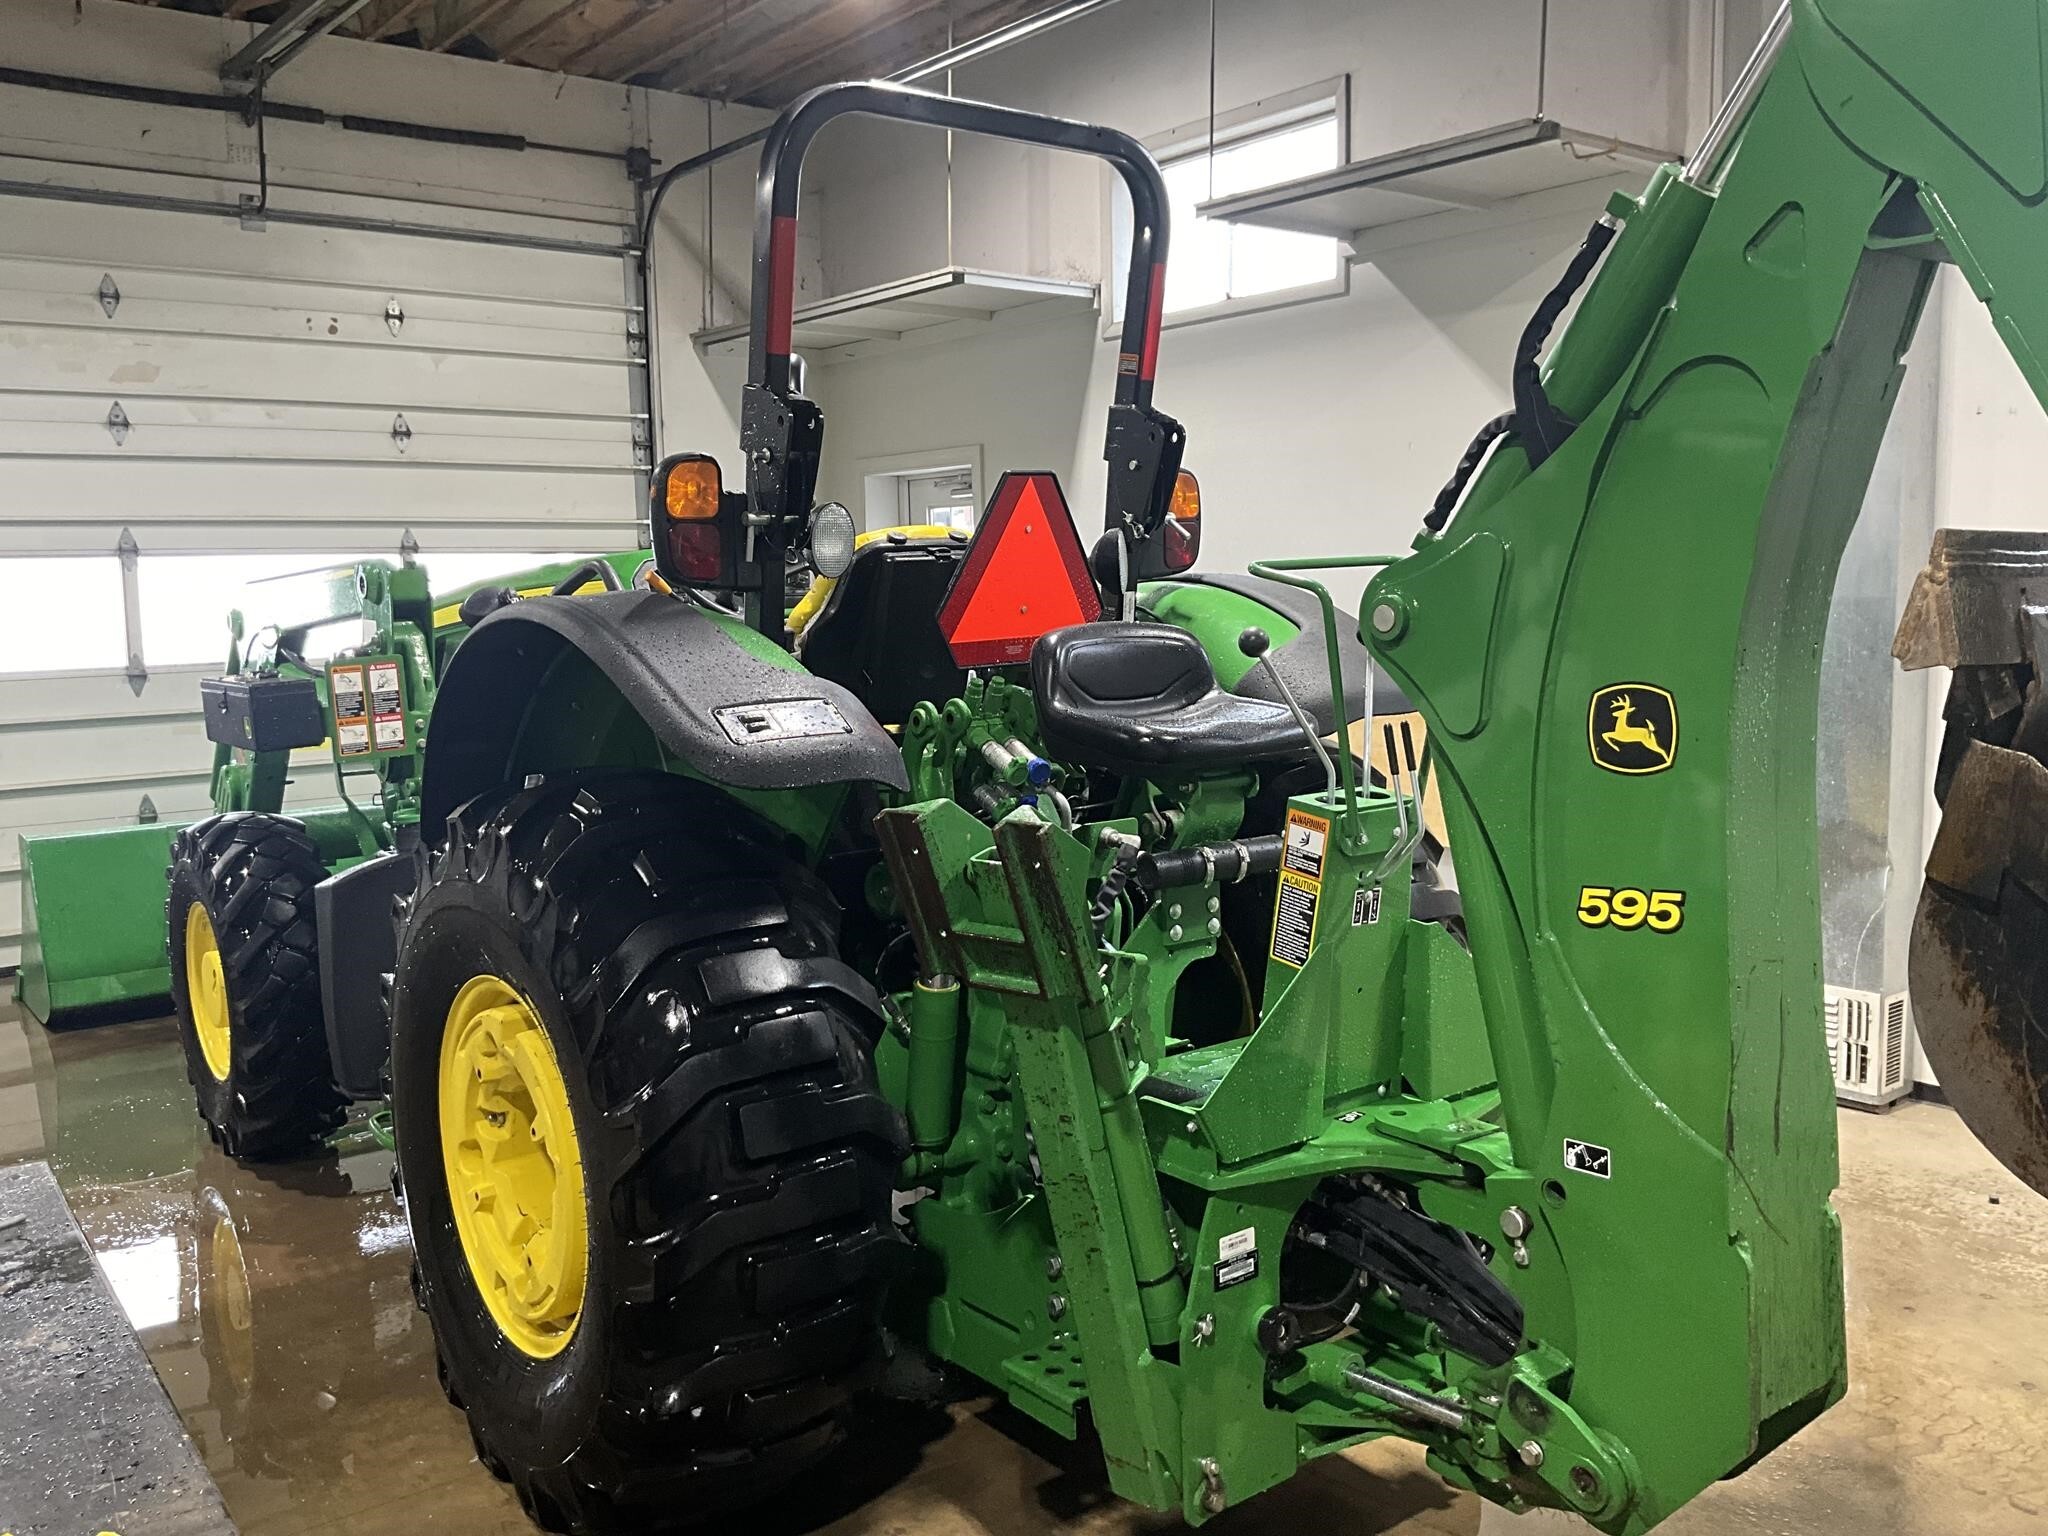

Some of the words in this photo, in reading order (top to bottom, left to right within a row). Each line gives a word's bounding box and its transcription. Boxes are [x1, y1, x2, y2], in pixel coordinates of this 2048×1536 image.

[1297, 814, 1327, 832] WARNING
[1290, 876, 1319, 894] CAUTION
[1577, 886, 1686, 933] 595
